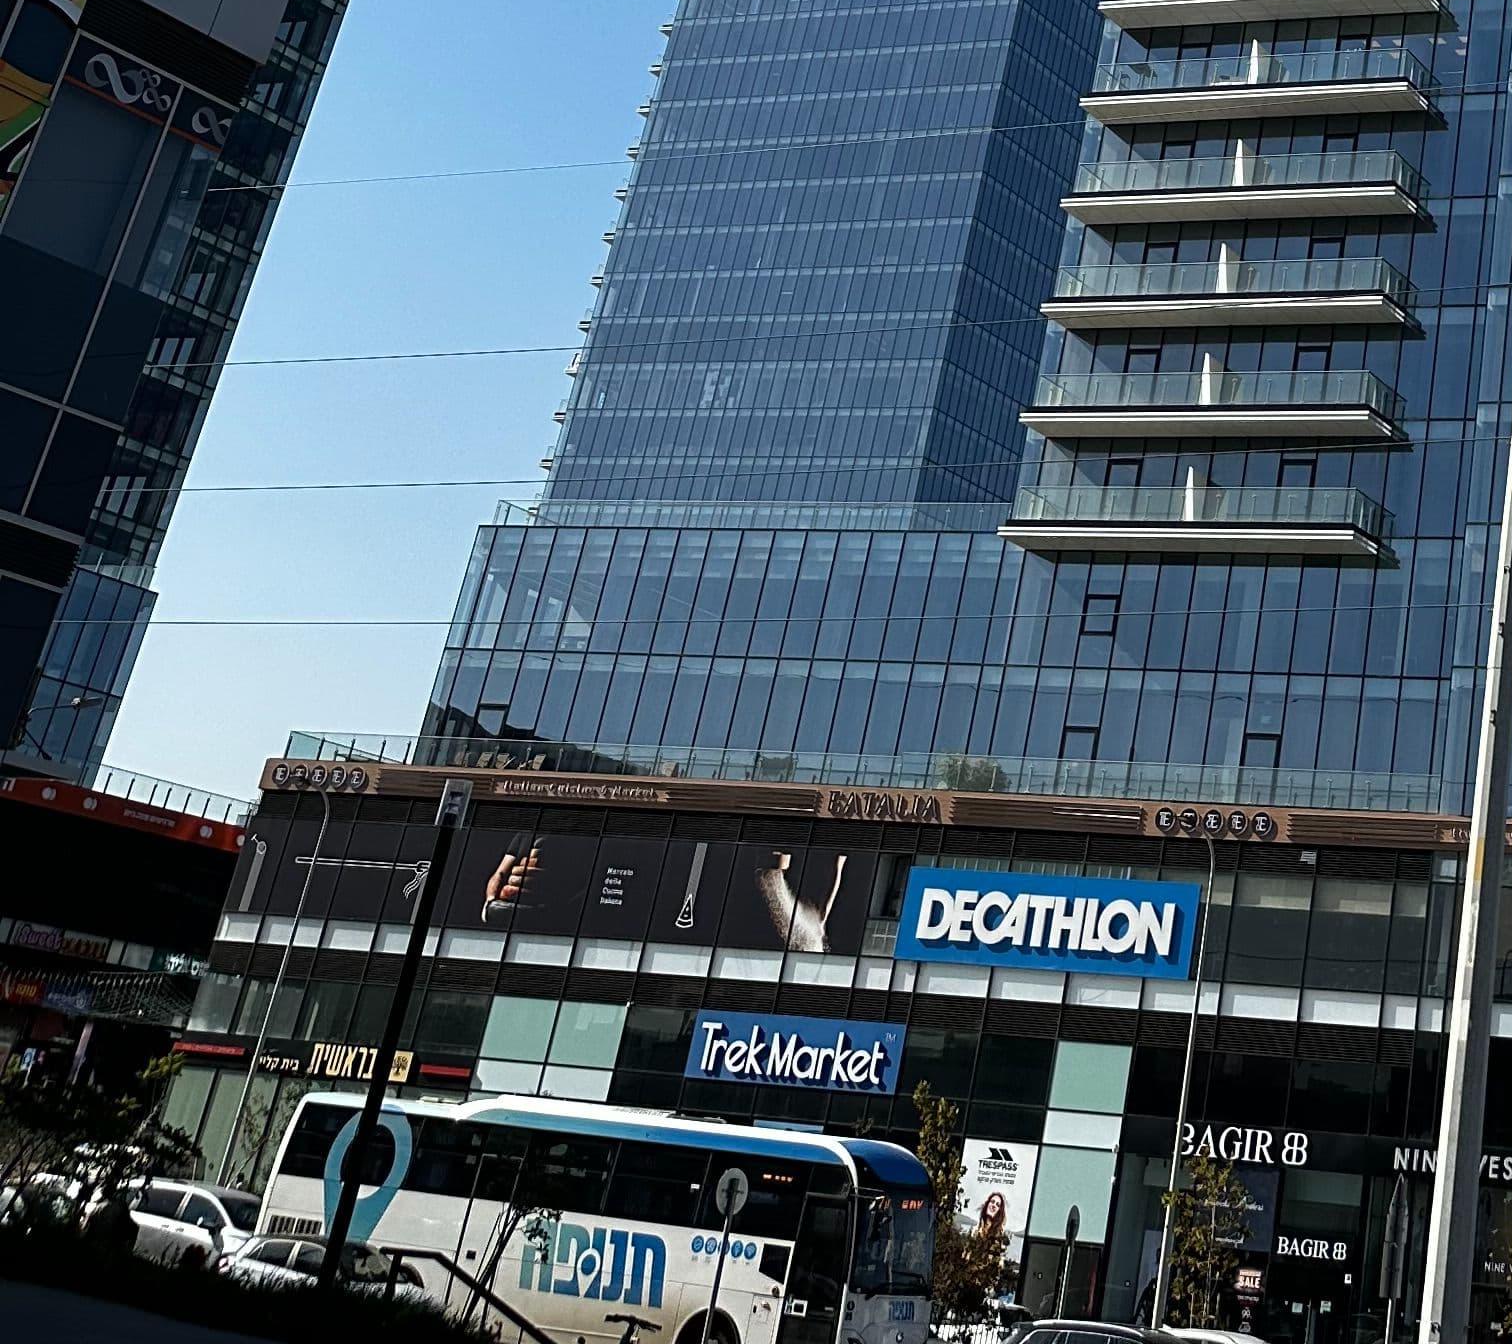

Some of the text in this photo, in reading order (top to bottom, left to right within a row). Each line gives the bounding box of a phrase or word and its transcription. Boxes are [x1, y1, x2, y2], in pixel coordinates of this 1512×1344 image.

[915, 888, 1176, 956] DECATHLON
[260, 1055, 280, 1072] קליי
[307, 1043, 378, 1079] בראשית
[1180, 1121, 1275, 1164] BAGIR
[978, 1159, 1019, 1173] TRESPASS
[1393, 1146, 1438, 1173] NIN
[519, 1218, 667, 1308] תנופה
[1277, 1236, 1330, 1259] BAGIR
